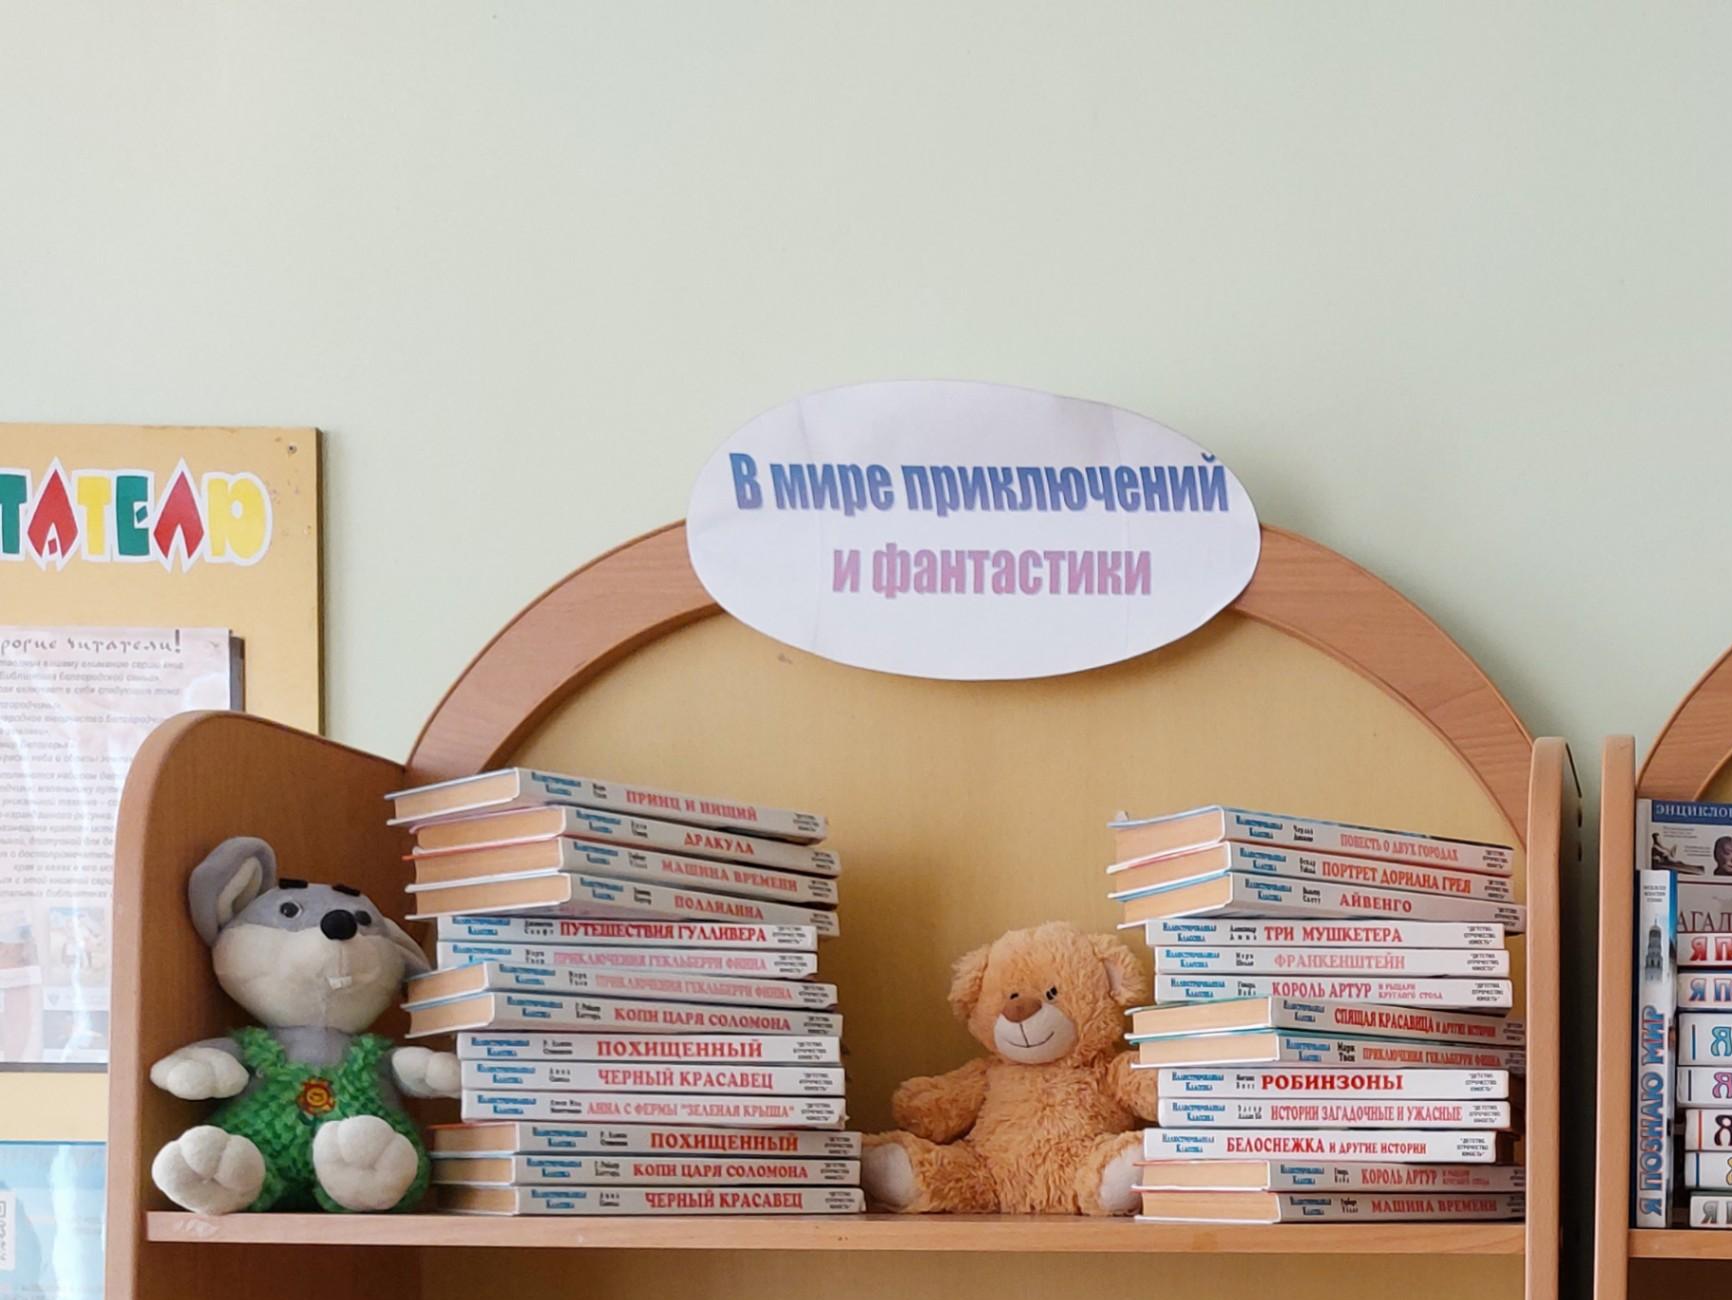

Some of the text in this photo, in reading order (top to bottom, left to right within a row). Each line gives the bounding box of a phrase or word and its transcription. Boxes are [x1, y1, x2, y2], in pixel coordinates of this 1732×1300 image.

[729, 452, 1230, 519] В мире приключений
[832, 542, 1152, 599] и фантастики
[684, 832, 755, 855] ДРАКУЛА
[661, 859, 798, 893] МАШИНА ВРЕМЕНИ
[1322, 861, 1379, 882] ПОРТРЕТ
[1441, 876, 1471, 894] ГРЕЯ
[1339, 891, 1412, 913] АЙВЕНГО
[560, 922, 767, 944] ПУТЕШЕСТВИЯ ГУЛЛИВЕРА
[1264, 926, 1403, 943] ТРИ МУШКЕТЕРА
[1274, 951, 1405, 969] ФРАНКЕНШТЕЙН
[1691, 937, 1707, 962] Я
[1272, 980, 1372, 999] КОРОЛЬ АРТУР
[615, 1007, 792, 1031] КОПИ ЦАРЯ СОЛОМОНА
[597, 1037, 763, 1058] ПОХИЩЕННЫЙ
[598, 1068, 774, 1091] ЧЕРНЫЙ КРАСАВЕЦ
[1261, 1074, 1404, 1090] РОБИНЗОНЫ
[650, 1130, 799, 1153] ПОХИЩЕННЫЙ
[1226, 1137, 1325, 1153] БЕЛОСНЕЖКА
[633, 1163, 809, 1180] КОПИ ЦАРЯ СОЛОМОНА
[644, 1189, 803, 1211] ЧЕРНЫЙ КРАСАВЕЦ
